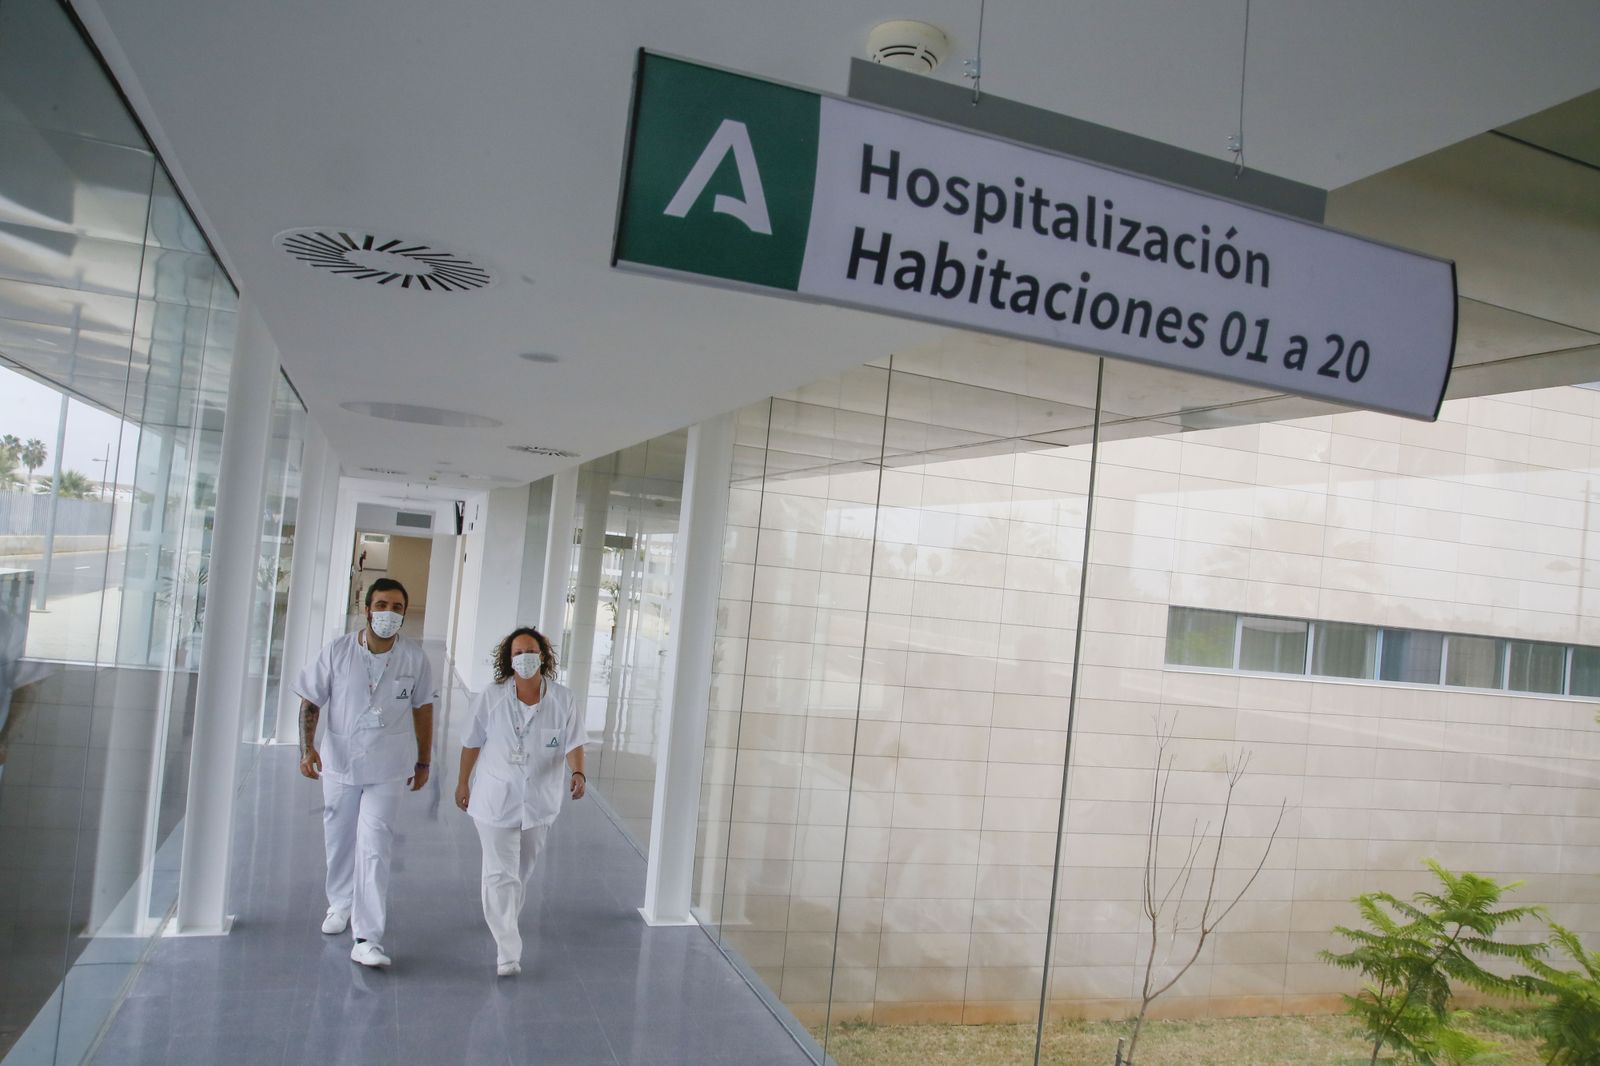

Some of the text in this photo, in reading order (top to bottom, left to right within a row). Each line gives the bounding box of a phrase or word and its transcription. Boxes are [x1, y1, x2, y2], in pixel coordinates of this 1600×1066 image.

[859, 142, 1271, 289] Hospitalización
[845, 225, 1371, 383] Habitaciones 01 a 20
